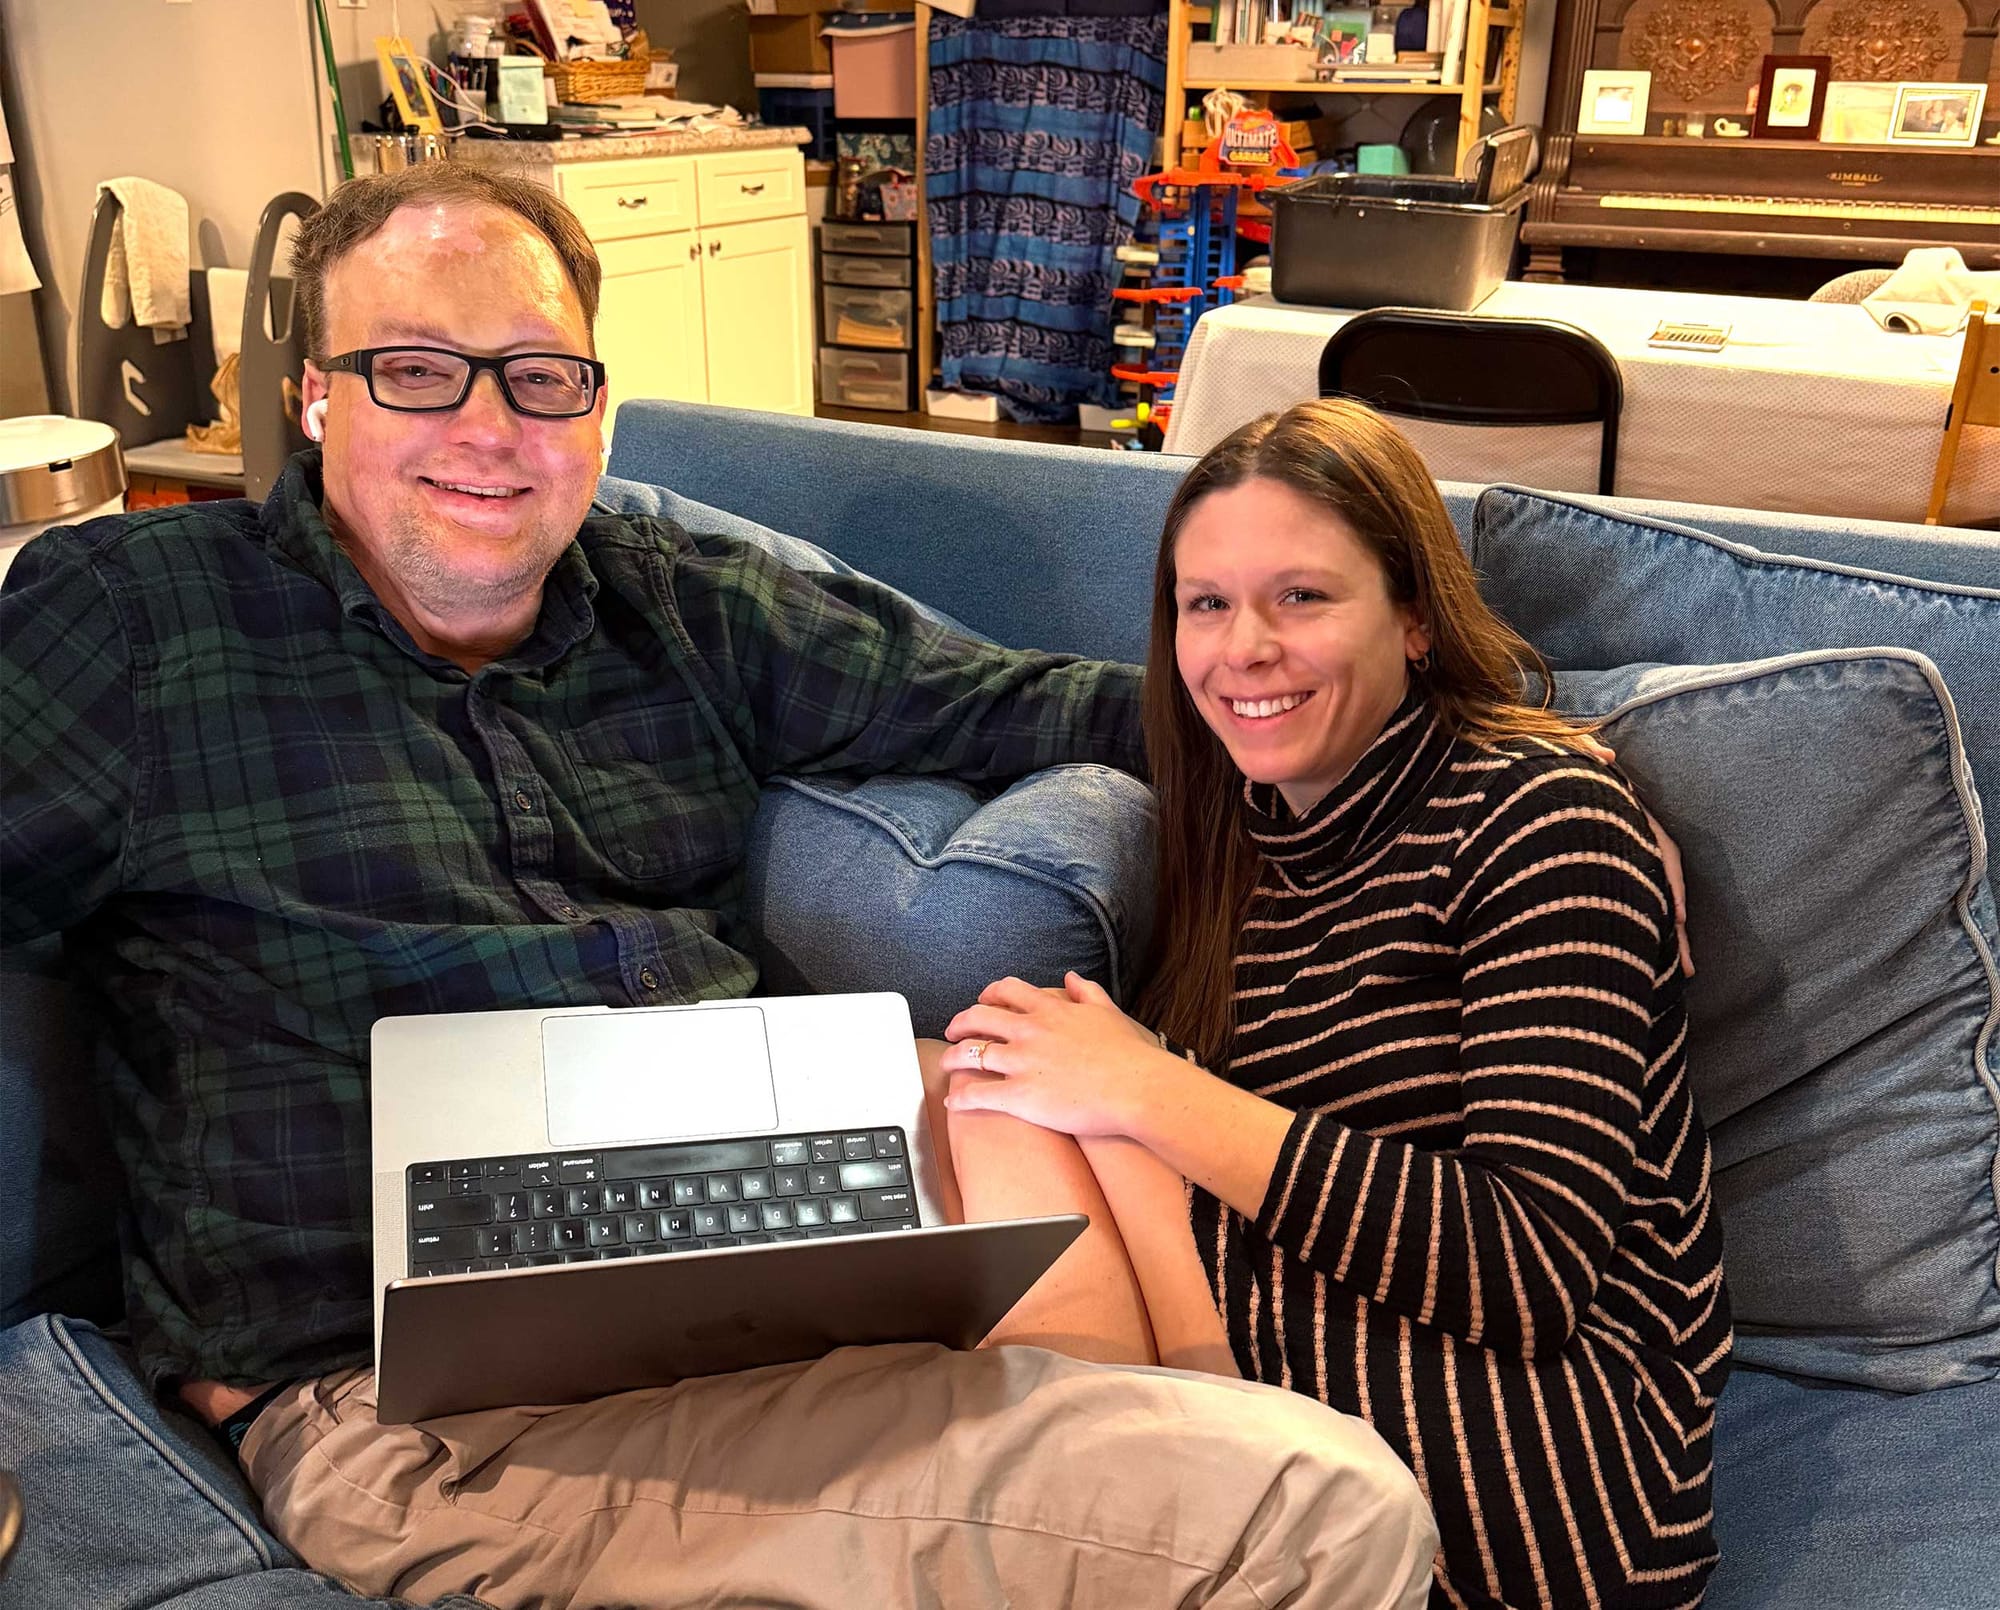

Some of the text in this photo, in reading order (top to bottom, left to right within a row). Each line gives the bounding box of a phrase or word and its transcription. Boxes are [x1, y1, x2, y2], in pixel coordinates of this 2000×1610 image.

[1225, 125, 1278, 148] ULTIMATE
[1829, 172, 1881, 183] KIMBALL
[814, 1138, 834, 1147] option
[846, 1135, 867, 1144] control
[528, 1160, 550, 1170] option
[562, 1157, 594, 1167] command
[752, 1179, 761, 1190] C
[785, 1177, 793, 1188] X
[818, 1175, 826, 1185] Z
[686, 1186, 694, 1197] B
[719, 1184, 728, 1194] V
[616, 1192, 626, 1203] M
[651, 1189, 660, 1200] N
[418, 1203, 434, 1212] shift
[806, 1207, 814, 1216] S
[739, 1213, 748, 1223] F
[773, 1210, 781, 1220] D
[671, 1219, 680, 1229] H
[705, 1216, 714, 1226] G
[601, 1226, 609, 1236] K
[637, 1223, 644, 1233] J
[566, 1229, 574, 1239] L
[417, 1235, 440, 1244] return
